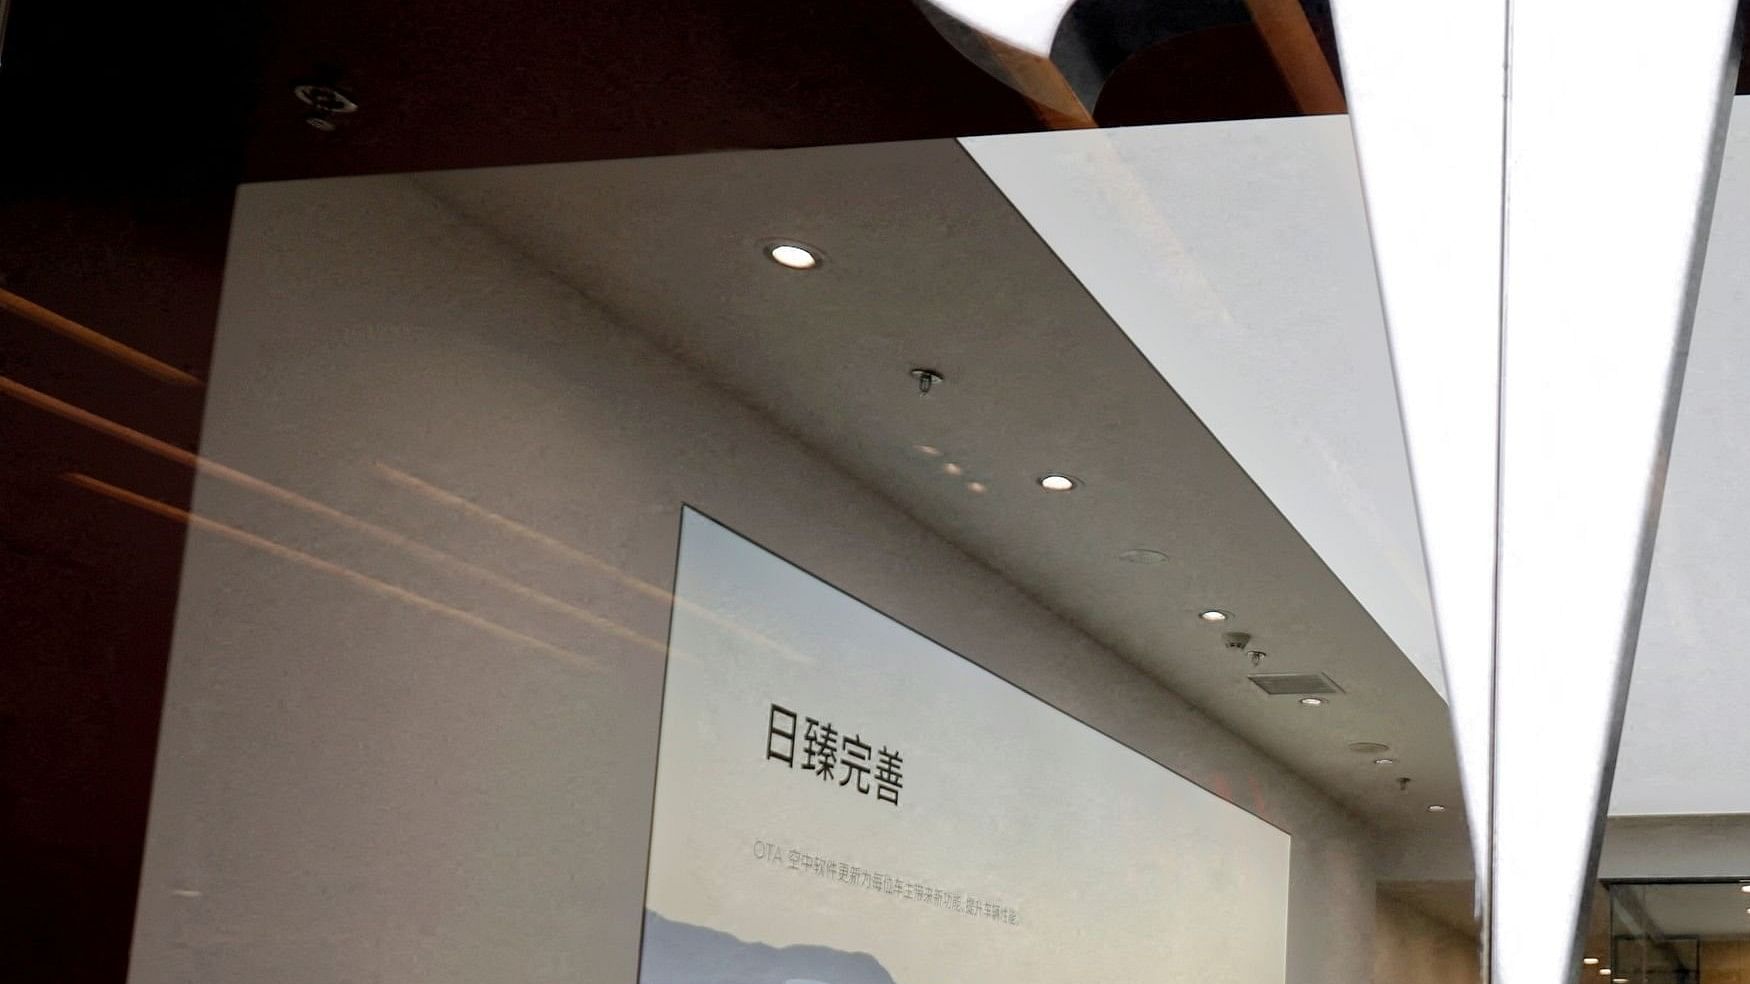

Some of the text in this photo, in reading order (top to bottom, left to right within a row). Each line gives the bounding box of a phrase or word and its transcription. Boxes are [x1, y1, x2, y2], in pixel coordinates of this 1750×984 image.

[766, 703, 904, 806] 日臻完善
[753, 840, 782, 862] OTA
